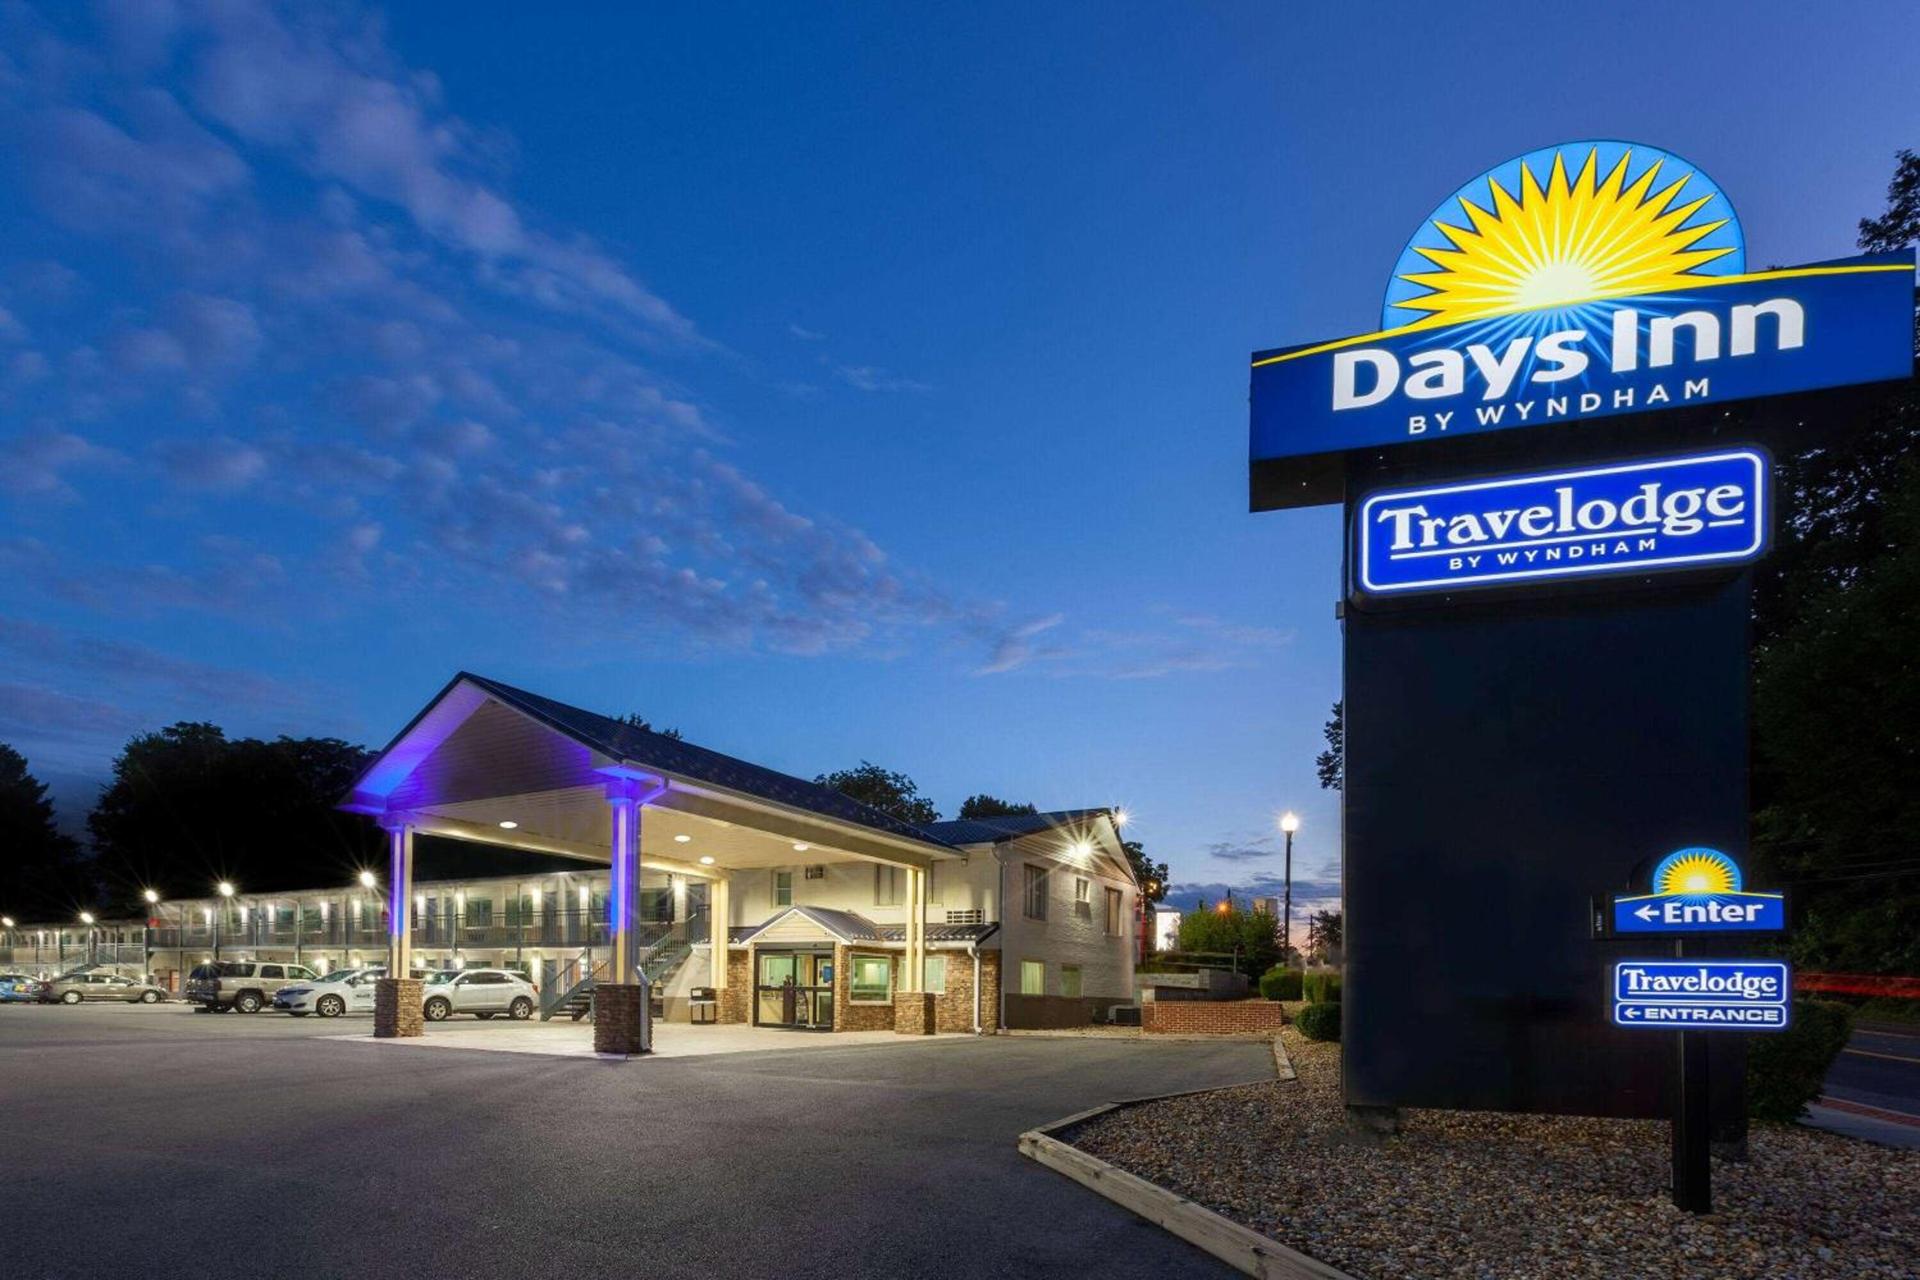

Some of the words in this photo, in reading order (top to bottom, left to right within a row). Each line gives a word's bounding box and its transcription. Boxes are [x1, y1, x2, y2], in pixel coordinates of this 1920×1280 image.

[1331, 329, 1588, 411] Days
[1612, 297, 1806, 373] Inn
[1408, 411, 1453, 436] BY
[1476, 378, 1711, 426] WYNDHAM
[1377, 482, 1745, 551] Travelodge
[1448, 556, 1481, 571] BY
[1498, 540, 1657, 565] WYNDHAM
[1664, 901, 1764, 924] Enter
[1622, 968, 1778, 999] Travelodge
[1644, 1008, 1779, 1022] ENTRANCE
